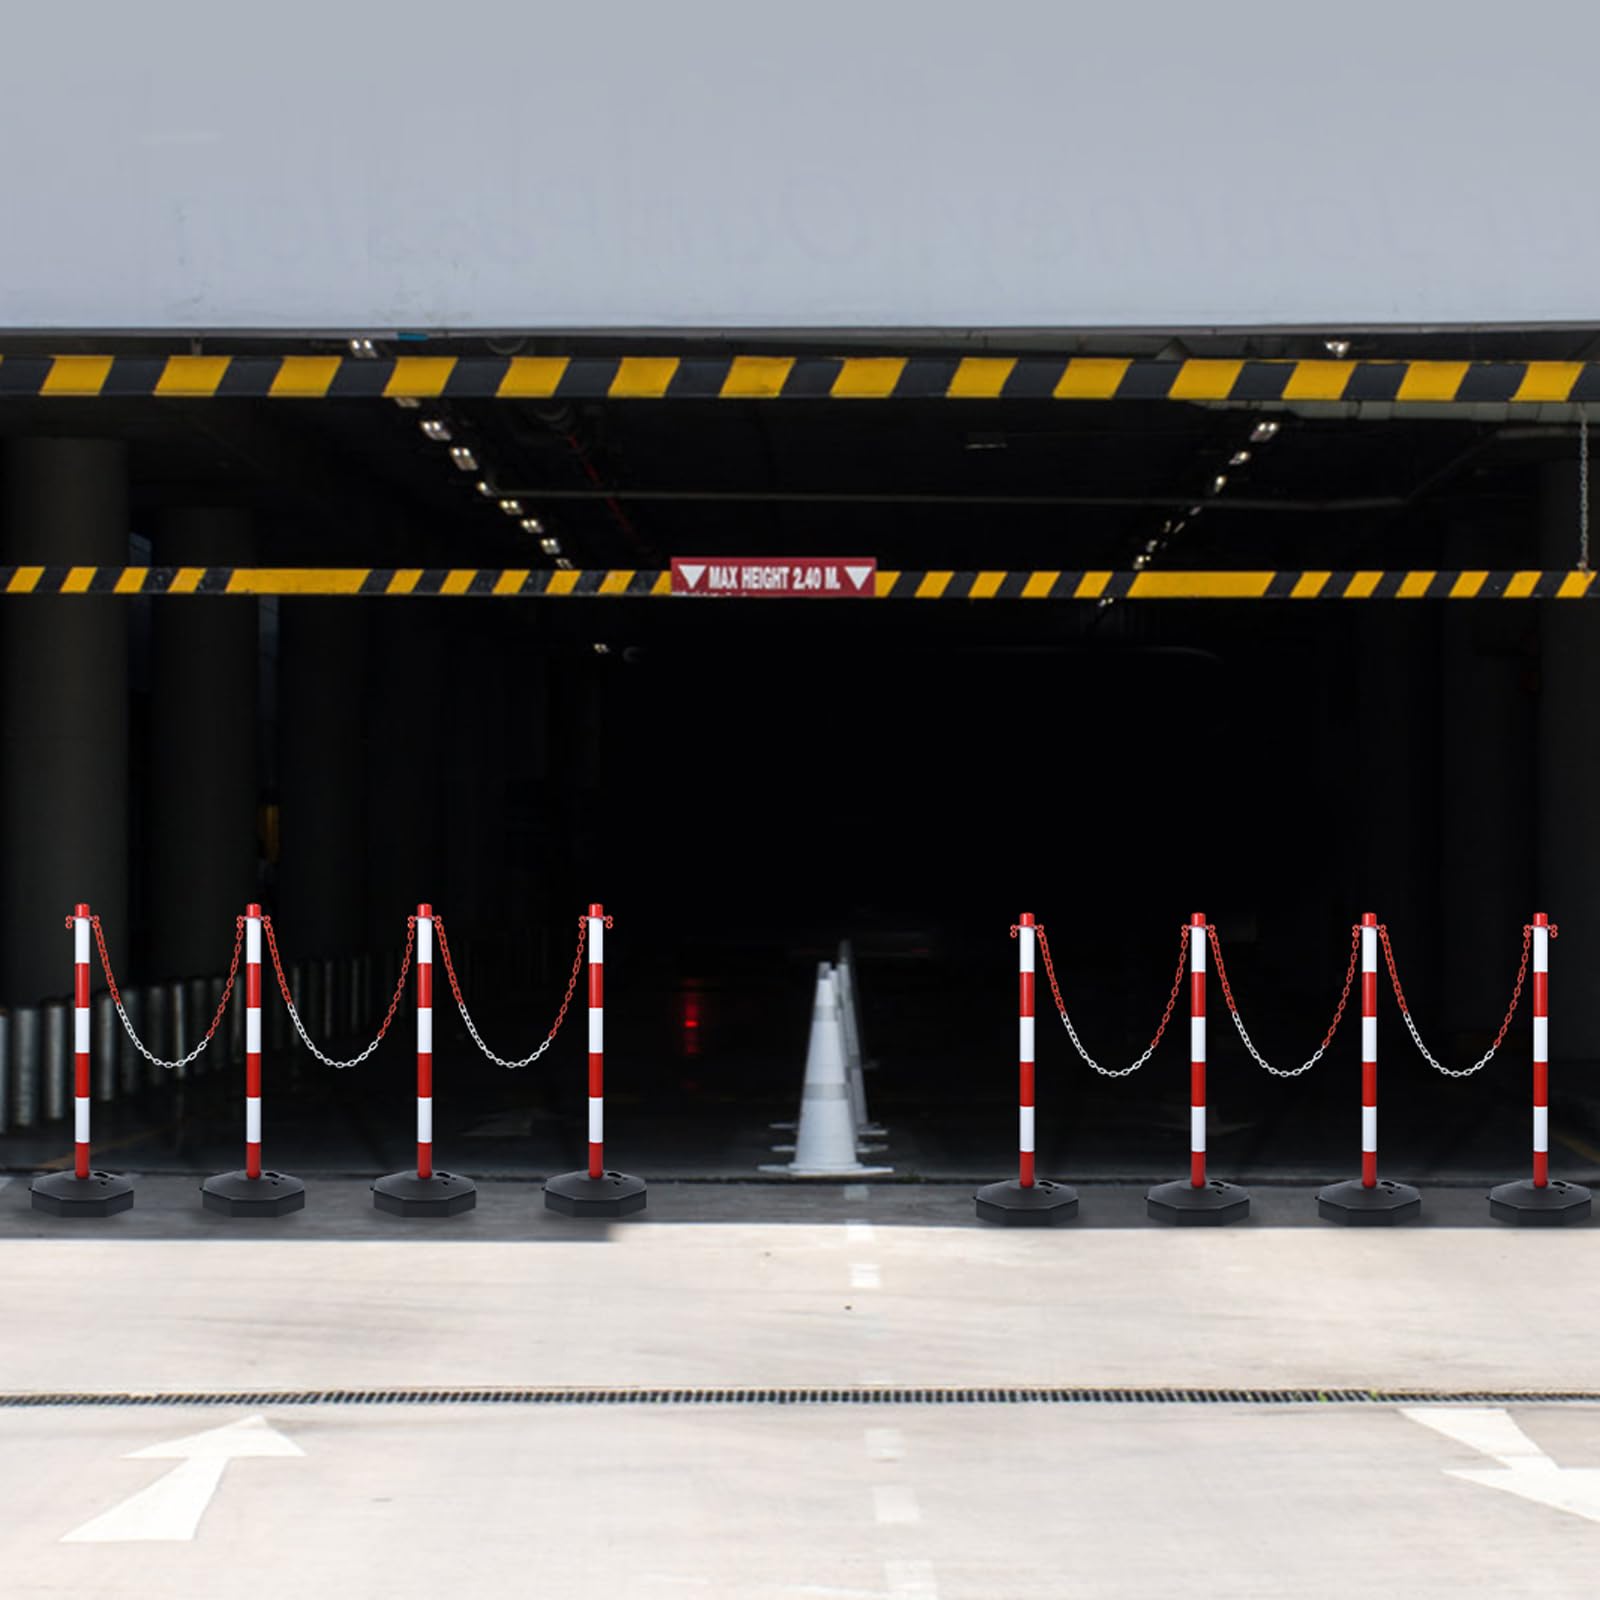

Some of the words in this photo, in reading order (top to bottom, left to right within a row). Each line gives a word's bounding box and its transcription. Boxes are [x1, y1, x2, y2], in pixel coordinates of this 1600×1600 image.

[708, 565, 738, 589] MAX
[742, 566, 789, 589] HEIGHT
[793, 566, 821, 589] 2.40
